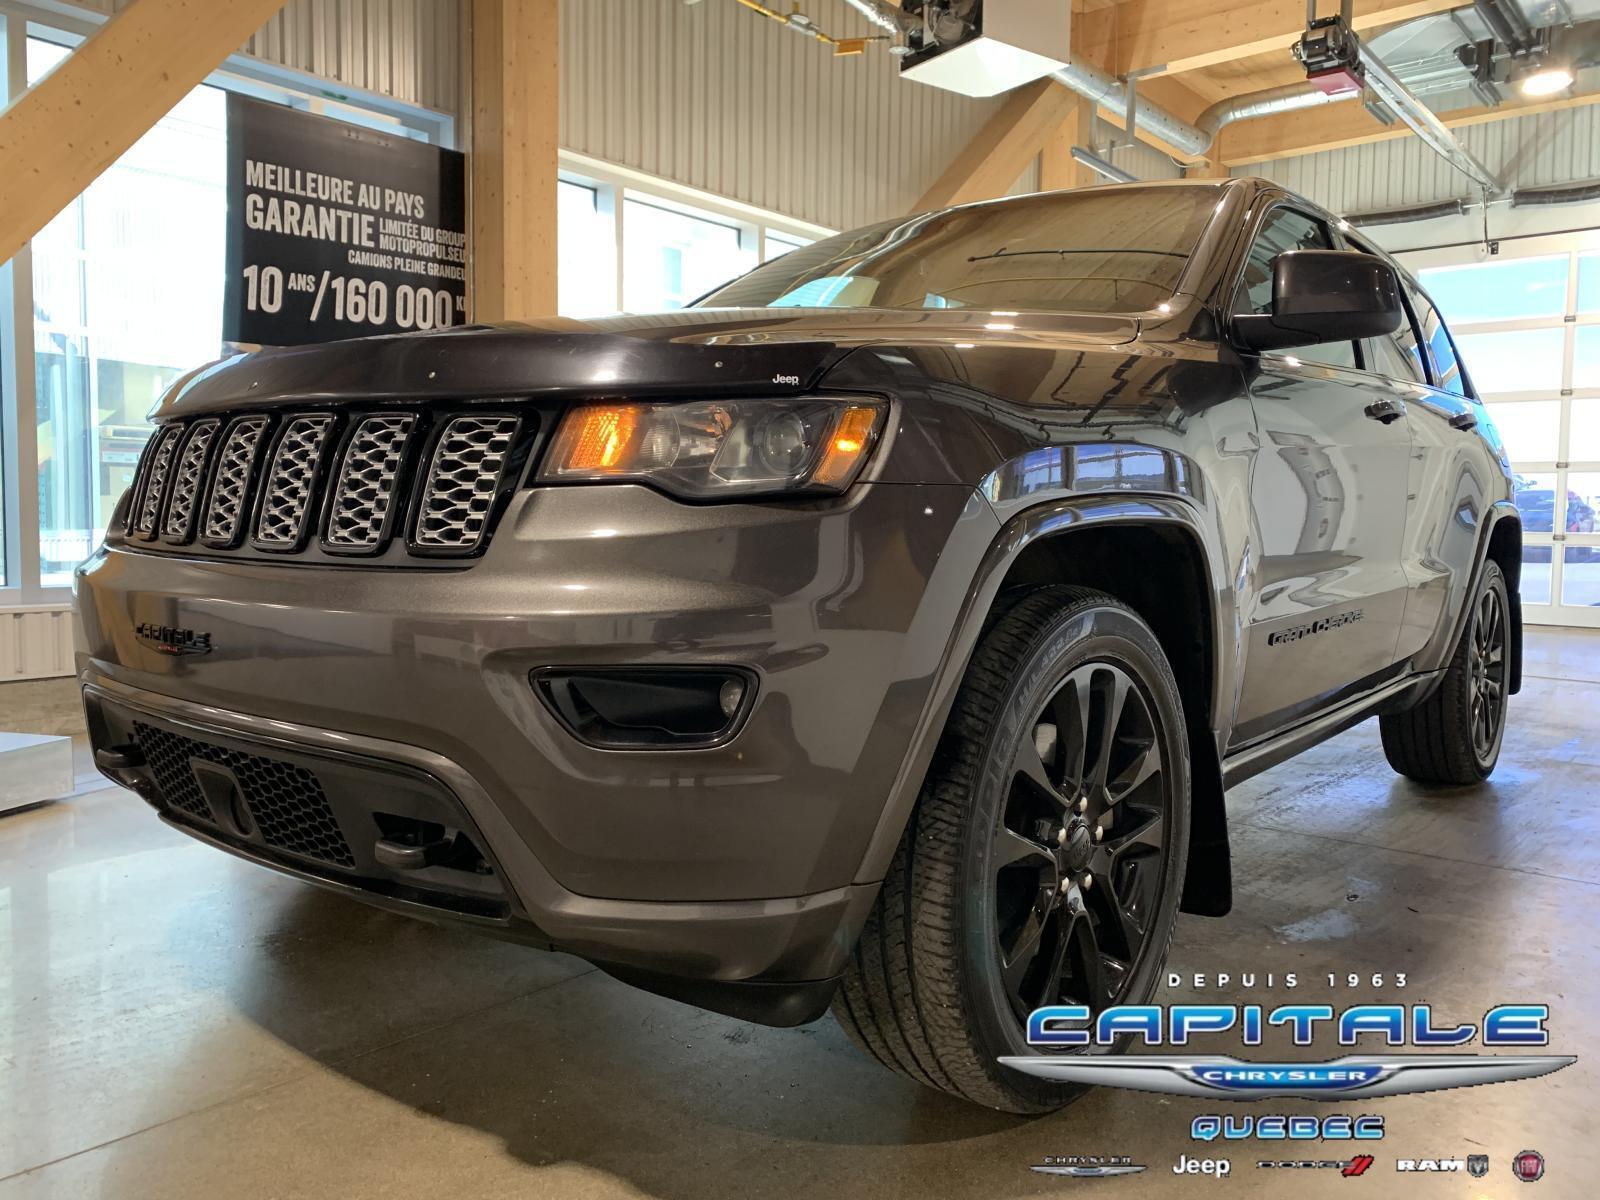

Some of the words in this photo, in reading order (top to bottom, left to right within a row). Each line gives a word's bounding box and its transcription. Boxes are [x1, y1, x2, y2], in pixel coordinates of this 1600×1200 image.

[245, 159, 354, 205] MEILLEURE
[357, 183, 380, 210] AU
[384, 188, 425, 219] PAYS
[245, 193, 375, 248] GARANTIE
[379, 217, 419, 239] LIMITÉE
[420, 225, 434, 242] DU
[348, 249, 392, 270] CAMIONS
[394, 256, 426, 274] PLEINE
[243, 264, 283, 314] 10
[288, 272, 316, 293] ANS
[395, 284, 453, 331] 000
[772, 373, 799, 386] Jeep
